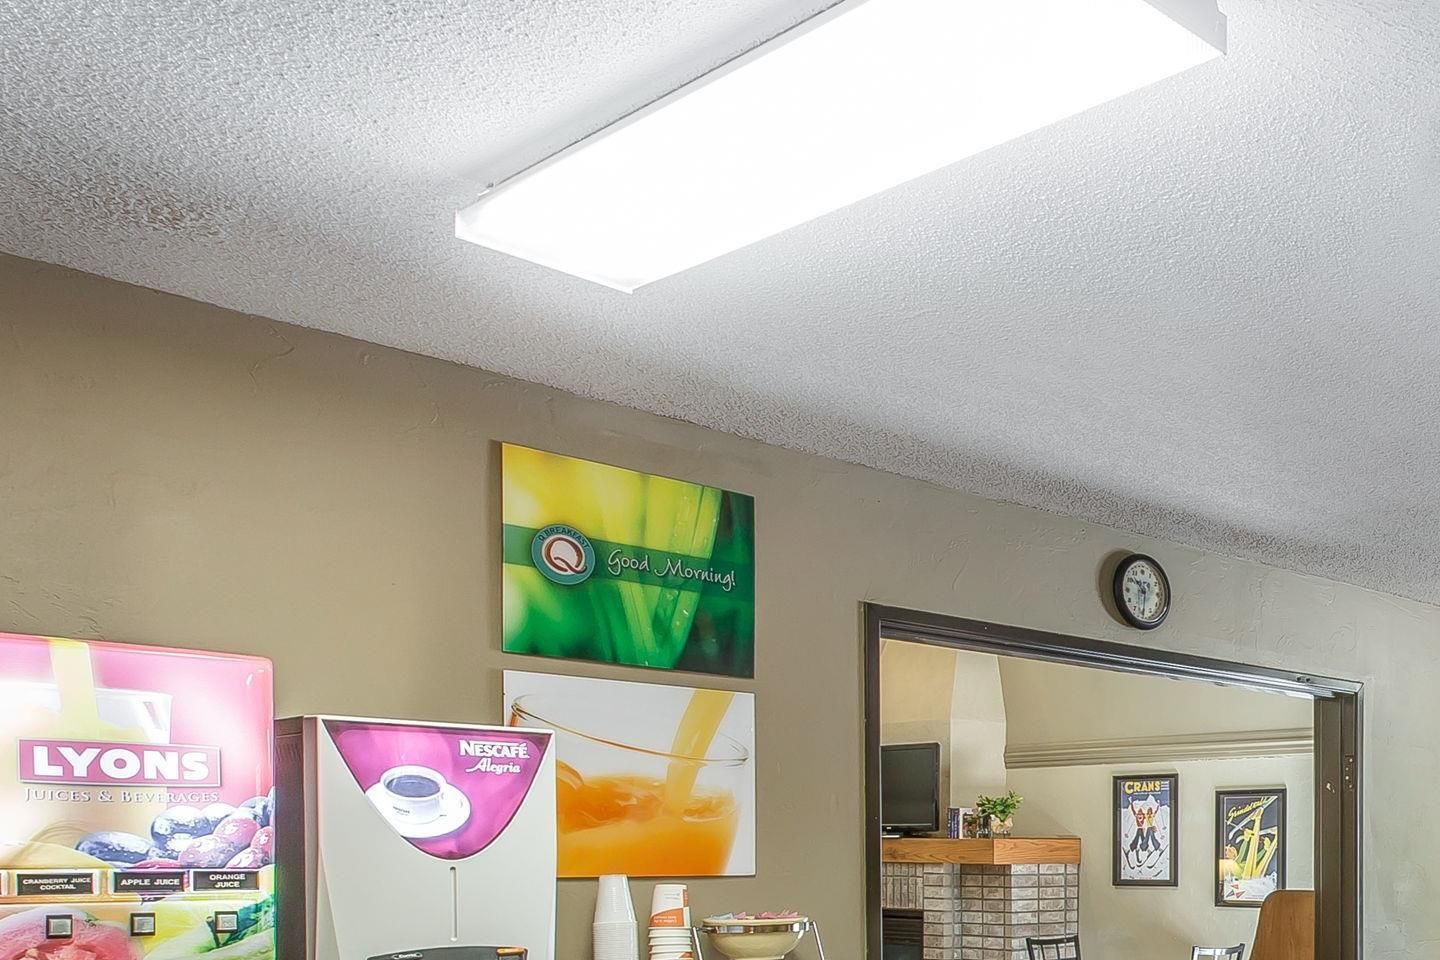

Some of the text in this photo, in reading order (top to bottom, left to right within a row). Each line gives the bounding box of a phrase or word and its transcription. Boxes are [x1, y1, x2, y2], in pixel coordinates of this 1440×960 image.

[544, 526, 590, 549] BREAKFAST
[544, 536, 588, 575] Q
[608, 549, 736, 592] Good Morning!
[459, 739, 531, 759] NESCAFÉ
[33, 746, 209, 781] LYONS
[464, 757, 521, 775] Alegria
[99, 789, 114, 802] &
[1124, 781, 1160, 794] CRANS
[120, 878, 180, 886] APPLE JUICE
[209, 873, 246, 881] ORANGE
[214, 880, 240, 888] JUICE
